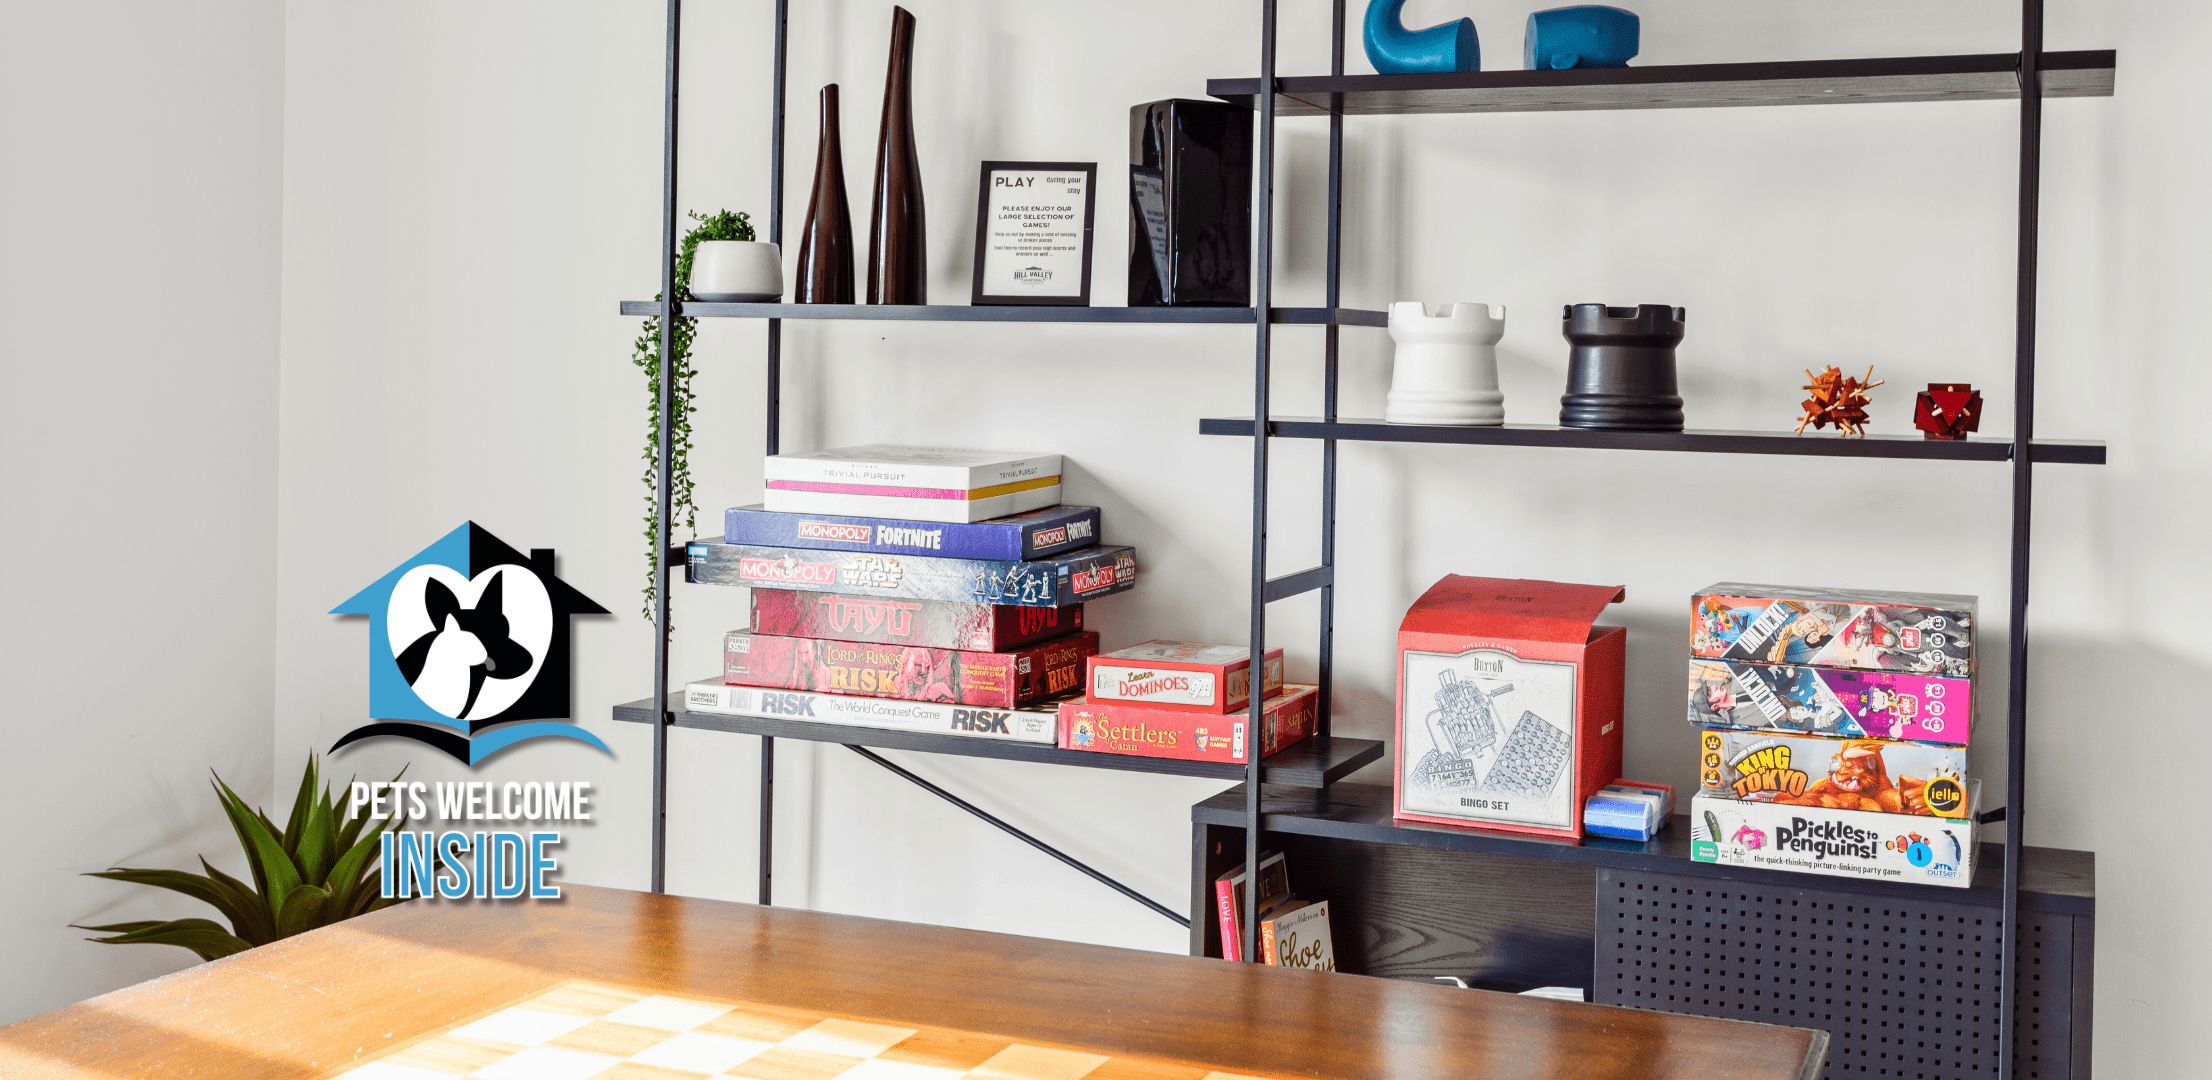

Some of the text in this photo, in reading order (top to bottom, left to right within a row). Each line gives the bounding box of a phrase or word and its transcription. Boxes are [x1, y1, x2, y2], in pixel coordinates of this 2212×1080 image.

[996, 177, 1034, 187] PLAY
[1014, 272, 1052, 280] HILL VALLEY
[824, 469, 906, 482] TRIVIAL PURSUIT
[1000, 469, 1016, 480] TRIVIAL
[800, 524, 942, 550] MONOPOLY FORTNITE
[1034, 519, 1092, 547] MONOPOLY FORTNITE
[843, 557, 902, 573] STAR
[841, 570, 902, 588] WARS
[1737, 604, 1790, 654] UNLOCK!
[828, 646, 904, 669] LORD RINGS
[1462, 642, 1488, 650] NOVELTY
[1496, 644, 1517, 654] GAMES
[1128, 671, 1154, 683] Learn
[1474, 658, 1504, 673] BUXTON
[830, 666, 900, 694] RISK
[1048, 664, 1078, 694] RISK
[1119, 677, 1190, 698] DOMINOES
[761, 692, 816, 718] RISK
[1736, 666, 1788, 722] UNLOCK!
[830, 700, 940, 720] The World Conquest Game
[951, 708, 1012, 734] RISK
[1097, 720, 1178, 746] Settlers
[1110, 740, 1138, 752] Catan
[1428, 762, 1472, 774] BINGO
[1736, 746, 1791, 776] KING
[1733, 768, 1808, 798] TOKYO
[1460, 798, 1510, 811] BINGO SET
[1792, 816, 1878, 843] Pickles to
[1776, 826, 1878, 860] Penguins!
[1766, 856, 1812, 869] quick-thinking
[1814, 861, 1862, 874] picture-linking
[1862, 866, 1882, 876] party
[1882, 868, 1902, 876] game
[1220, 896, 1232, 922] LOVE
[1264, 926, 1272, 950] Shoe
[1280, 931, 1324, 968] Shoe
